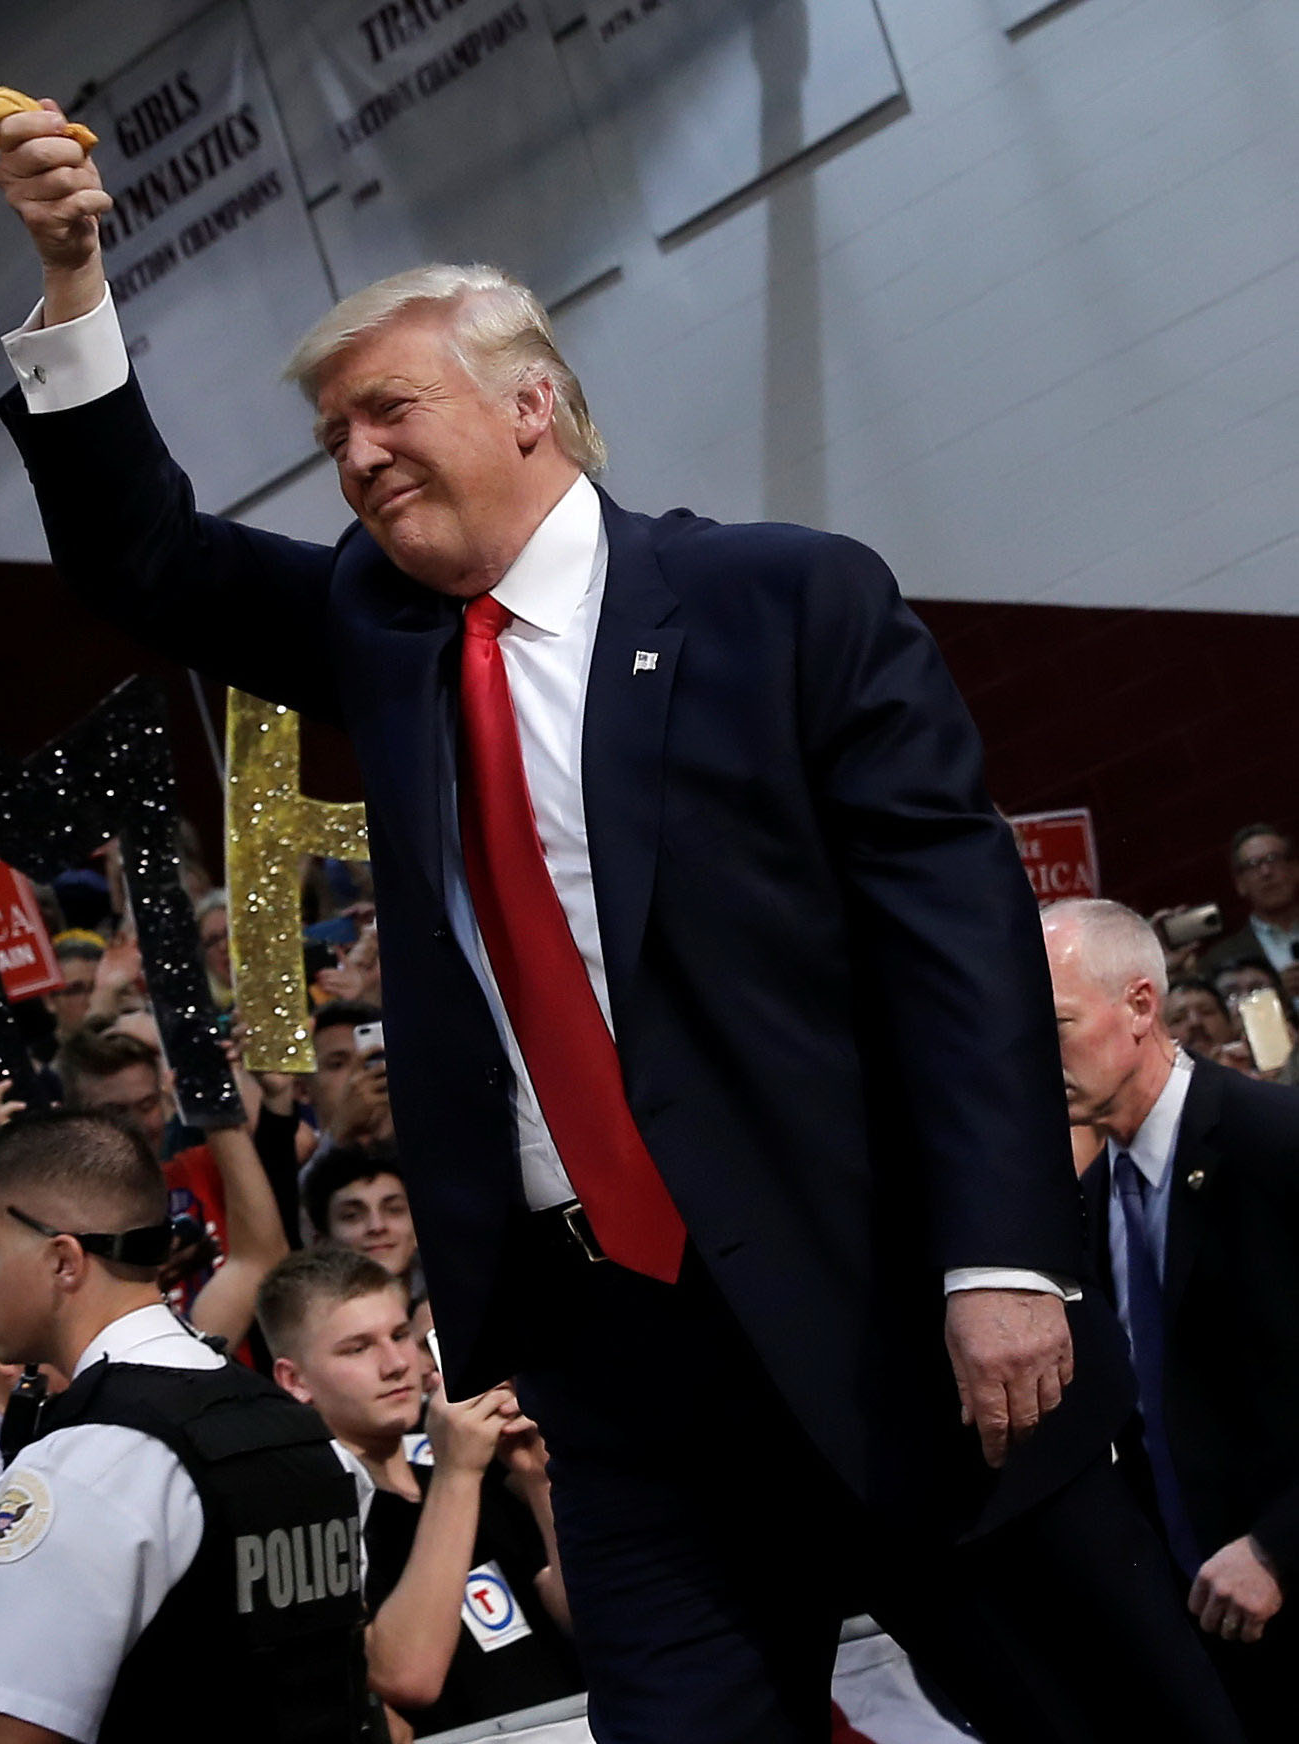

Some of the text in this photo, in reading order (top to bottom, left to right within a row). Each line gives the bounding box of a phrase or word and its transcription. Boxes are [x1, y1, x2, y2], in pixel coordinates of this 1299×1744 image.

[359, 0, 466, 62] TRA
[115, 69, 200, 158] GIRLS
[112, 241, 178, 302] ECTION
[236, 1516, 359, 1614] POLICE
